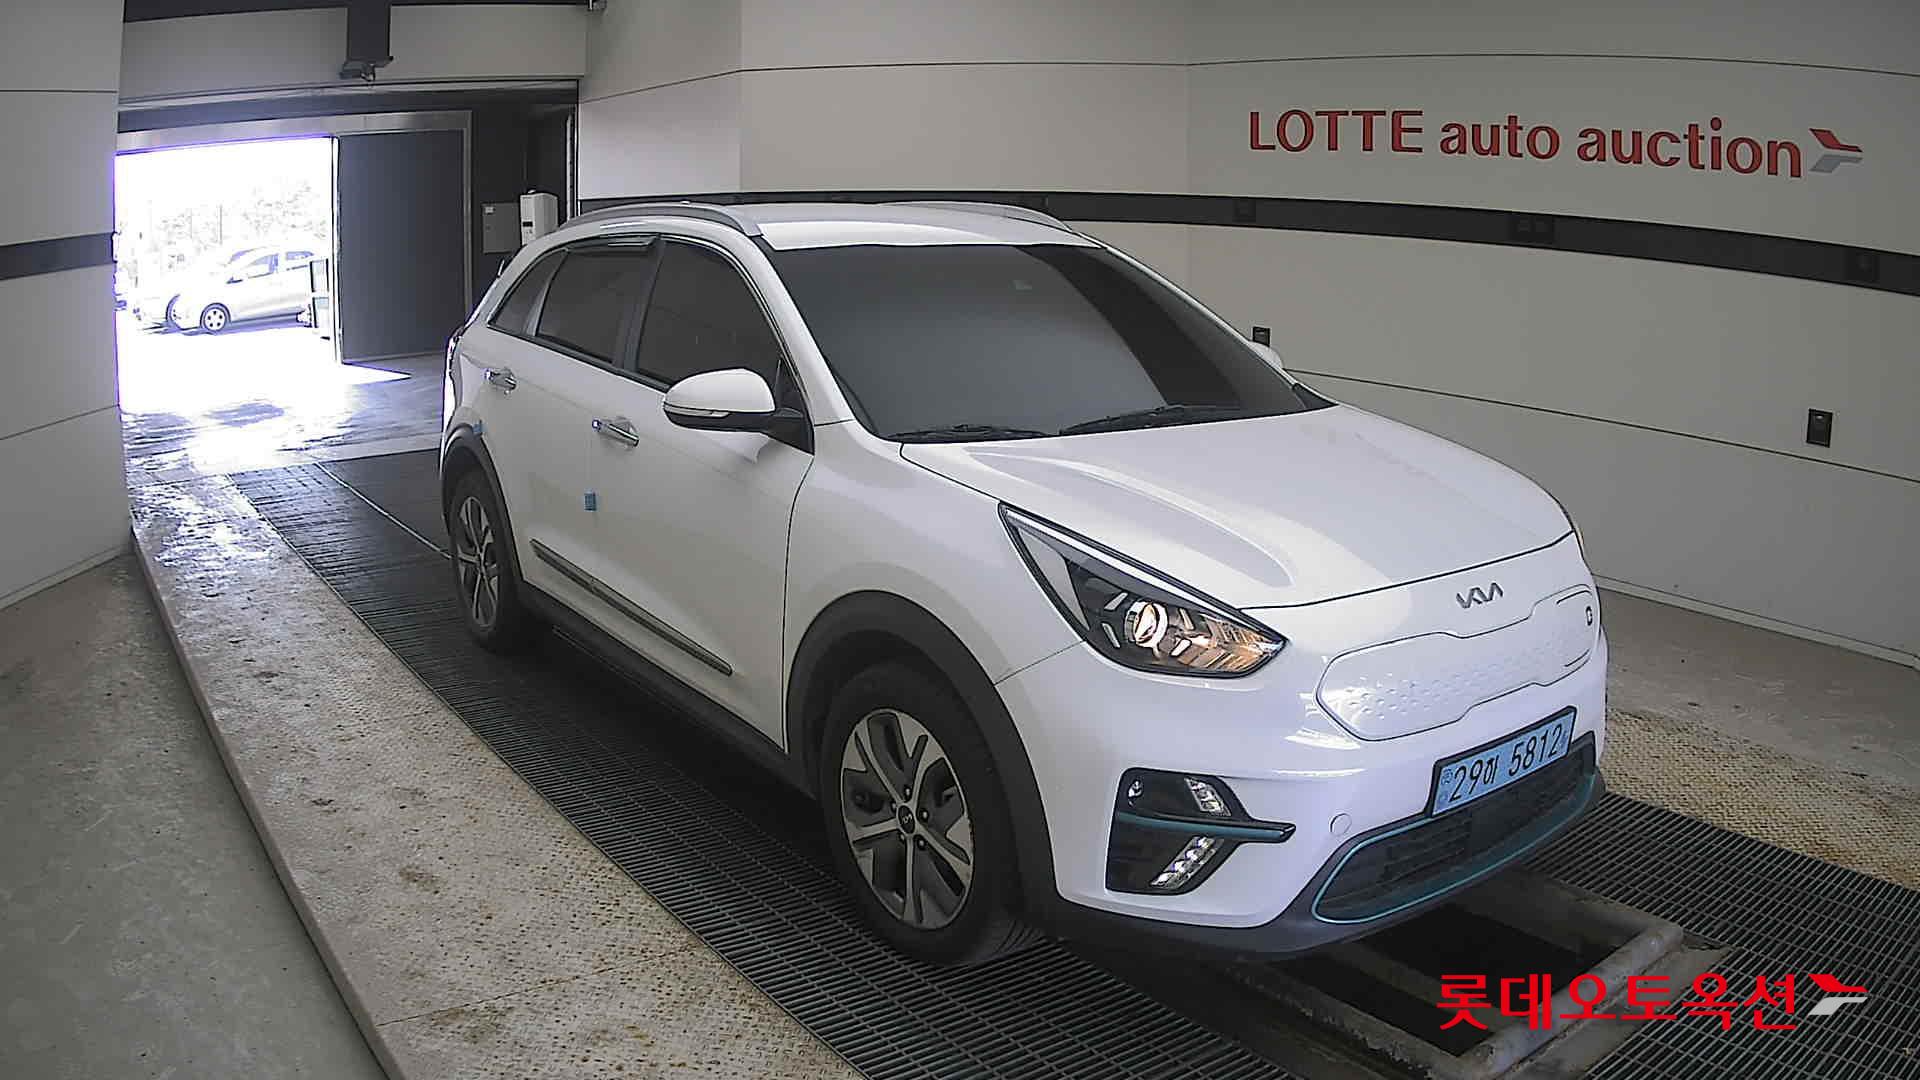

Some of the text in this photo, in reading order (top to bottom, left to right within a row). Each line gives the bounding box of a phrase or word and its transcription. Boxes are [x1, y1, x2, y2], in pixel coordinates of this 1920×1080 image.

[1250, 109, 1801, 178] LOTTE auto auction
[1508, 723, 1562, 776] 5812
